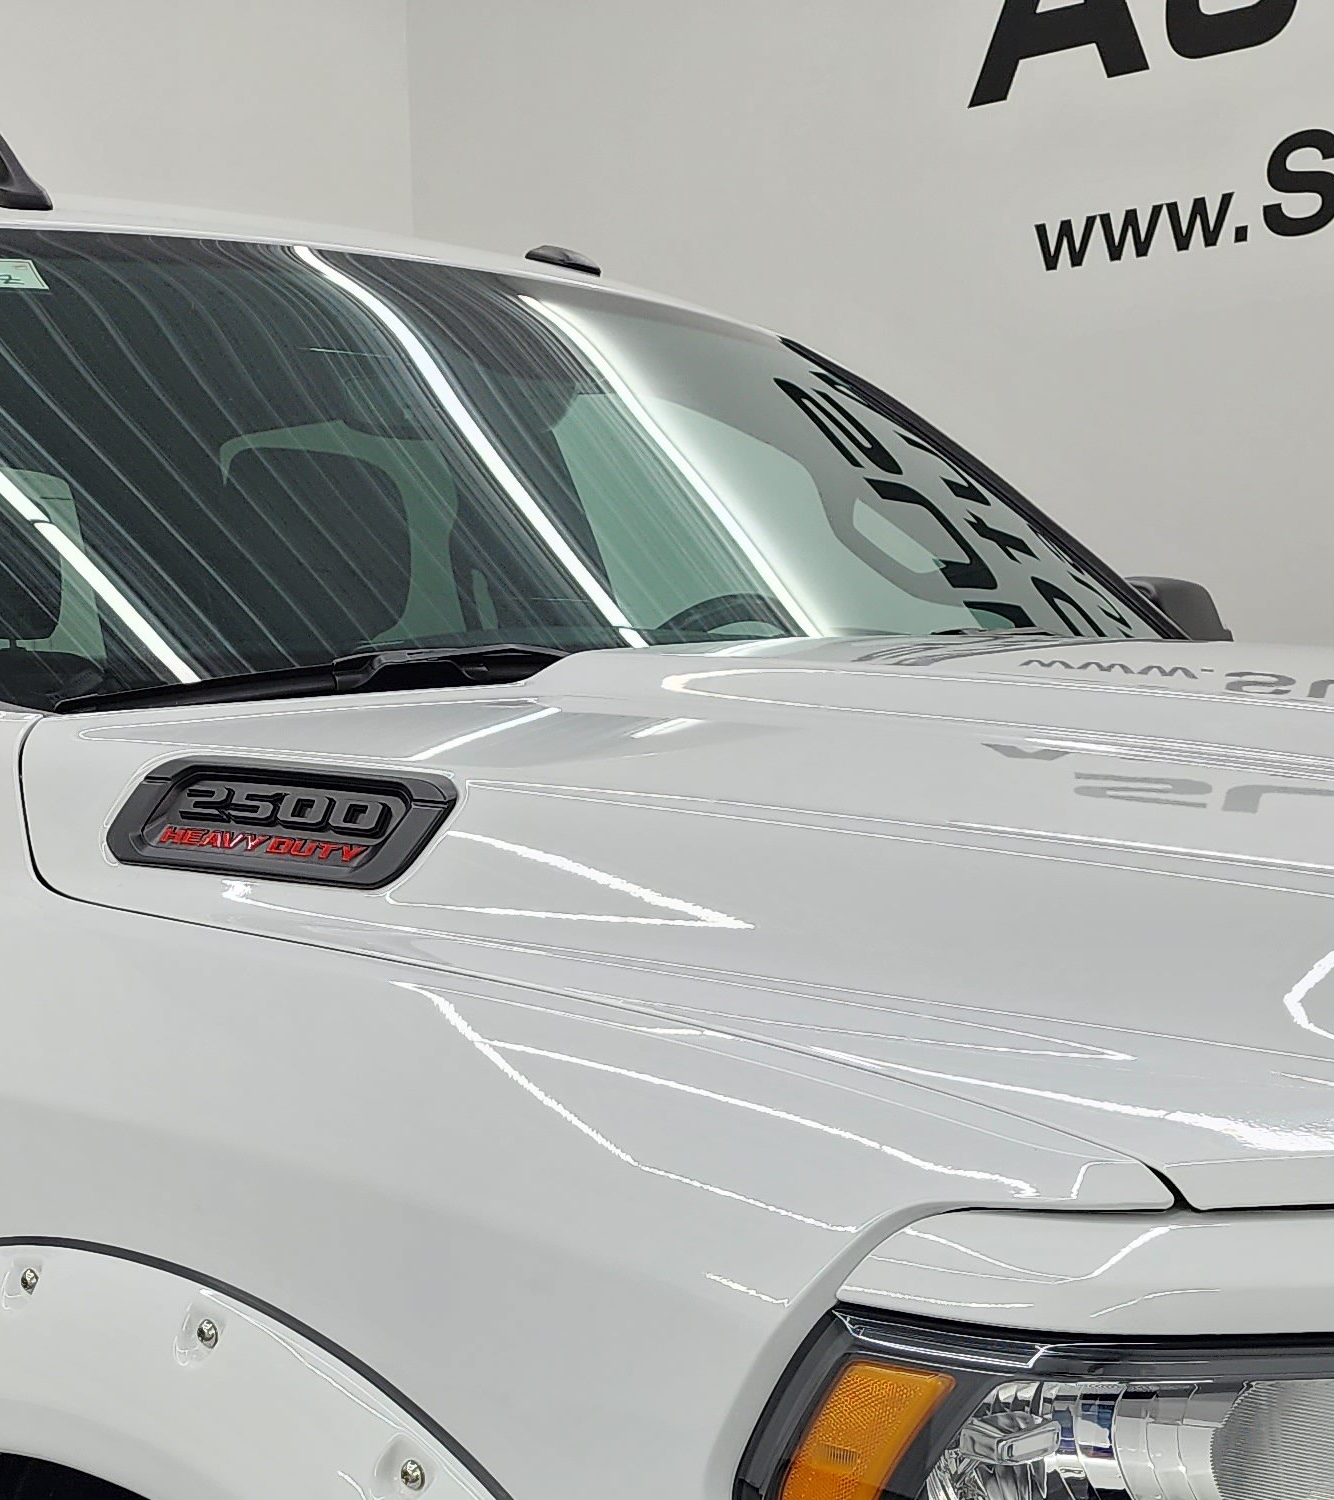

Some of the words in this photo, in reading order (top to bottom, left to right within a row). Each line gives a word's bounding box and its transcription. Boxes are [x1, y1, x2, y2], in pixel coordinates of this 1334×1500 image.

[179, 787, 393, 838] 2500
[160, 825, 267, 852] HEAVY
[266, 835, 369, 863] DUTY
